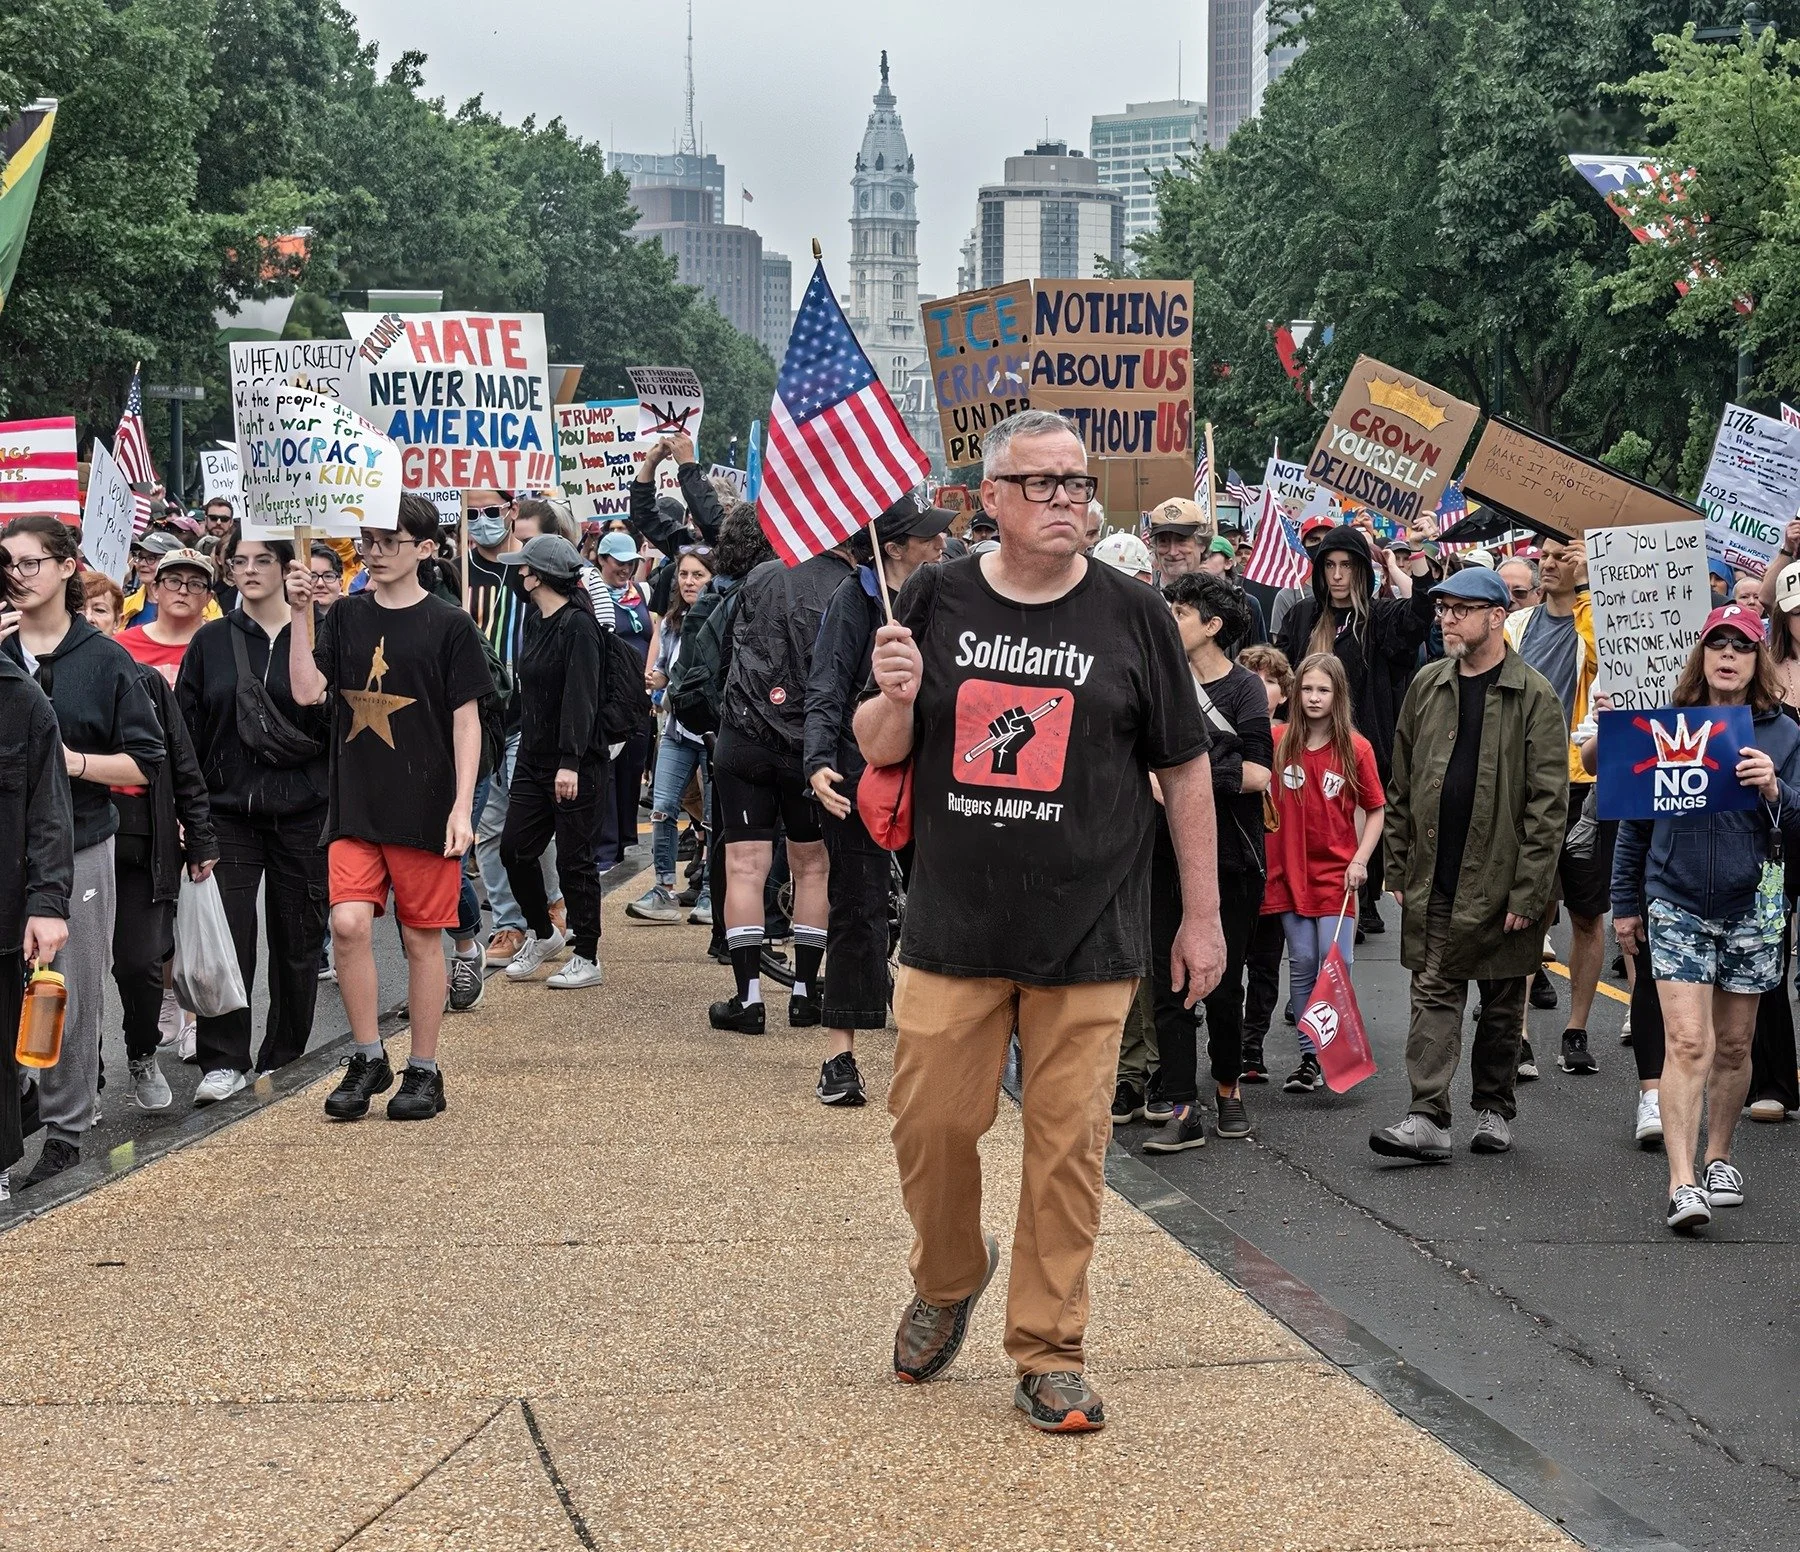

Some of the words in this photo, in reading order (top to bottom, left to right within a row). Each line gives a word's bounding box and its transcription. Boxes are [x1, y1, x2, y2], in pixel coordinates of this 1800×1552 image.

[1035, 290, 1189, 338] NOTHING
[927, 297, 1028, 359] I.C.E.
[405, 317, 528, 370] HATE
[234, 348, 289, 376] WHEN
[292, 343, 356, 373] CRUELTY
[1031, 349, 1140, 390] ABOUT
[1142, 347, 1189, 392] US
[647, 370, 695, 378] THRONES
[652, 377, 698, 385] CROWNS
[369, 370, 466, 407] NEVER
[475, 372, 543, 412] MADE
[638, 384, 657, 395] NO
[659, 385, 701, 398] KINGS
[252, 392, 270, 407] the
[276, 394, 326, 414] people
[333, 405, 353, 420] did
[269, 422, 275, 432] a
[280, 417, 322, 431] war
[333, 418, 363, 439] for
[385, 408, 543, 451] AMERICA
[587, 427, 615, 445] have
[1350, 408, 1442, 467] CROWN
[251, 436, 382, 469] DEMOCRACY
[1327, 424, 1438, 490] YOURSELF
[1496, 425, 1525, 448] THIS
[1528, 443, 1547, 459] IS
[1549, 452, 1578, 475] YOUR
[205, 455, 239, 475] Billio
[285, 467, 302, 488] by
[305, 471, 312, 481] a
[318, 465, 383, 488] KING
[610, 464, 635, 478] AND
[1273, 462, 1305, 483] NOT
[1487, 444, 1525, 467] MAKE
[1527, 461, 1548, 475] IT
[1550, 470, 1610, 502] PROTECT
[211, 477, 235, 489] Only
[585, 478, 616, 494] have
[1278, 481, 1317, 502] KING
[1484, 458, 1512, 481] PASS
[1518, 475, 1542, 490] IT
[1543, 488, 1565, 503] ON
[305, 493, 328, 514] wig
[331, 493, 364, 504] was
[1703, 482, 1738, 505] 2025
[1729, 510, 1781, 545] KINGS
[1586, 531, 1613, 561] IF
[1627, 530, 1657, 554] You
[1664, 529, 1699, 552] Love
[1593, 589, 1627, 607] Dont
[1606, 611, 1655, 634] APPLIES
[1660, 609, 1682, 626] TO
[1669, 629, 1701, 651] WHA
[955, 630, 1095, 686] Solidarity
[1603, 660, 1633, 682] YOU
[1636, 674, 1666, 690] Love
[1653, 768, 1709, 797] NO
[948, 791, 992, 817] Rutgers
[994, 798, 1064, 823] AAUP-AFT
[1653, 795, 1708, 812] KINGS
